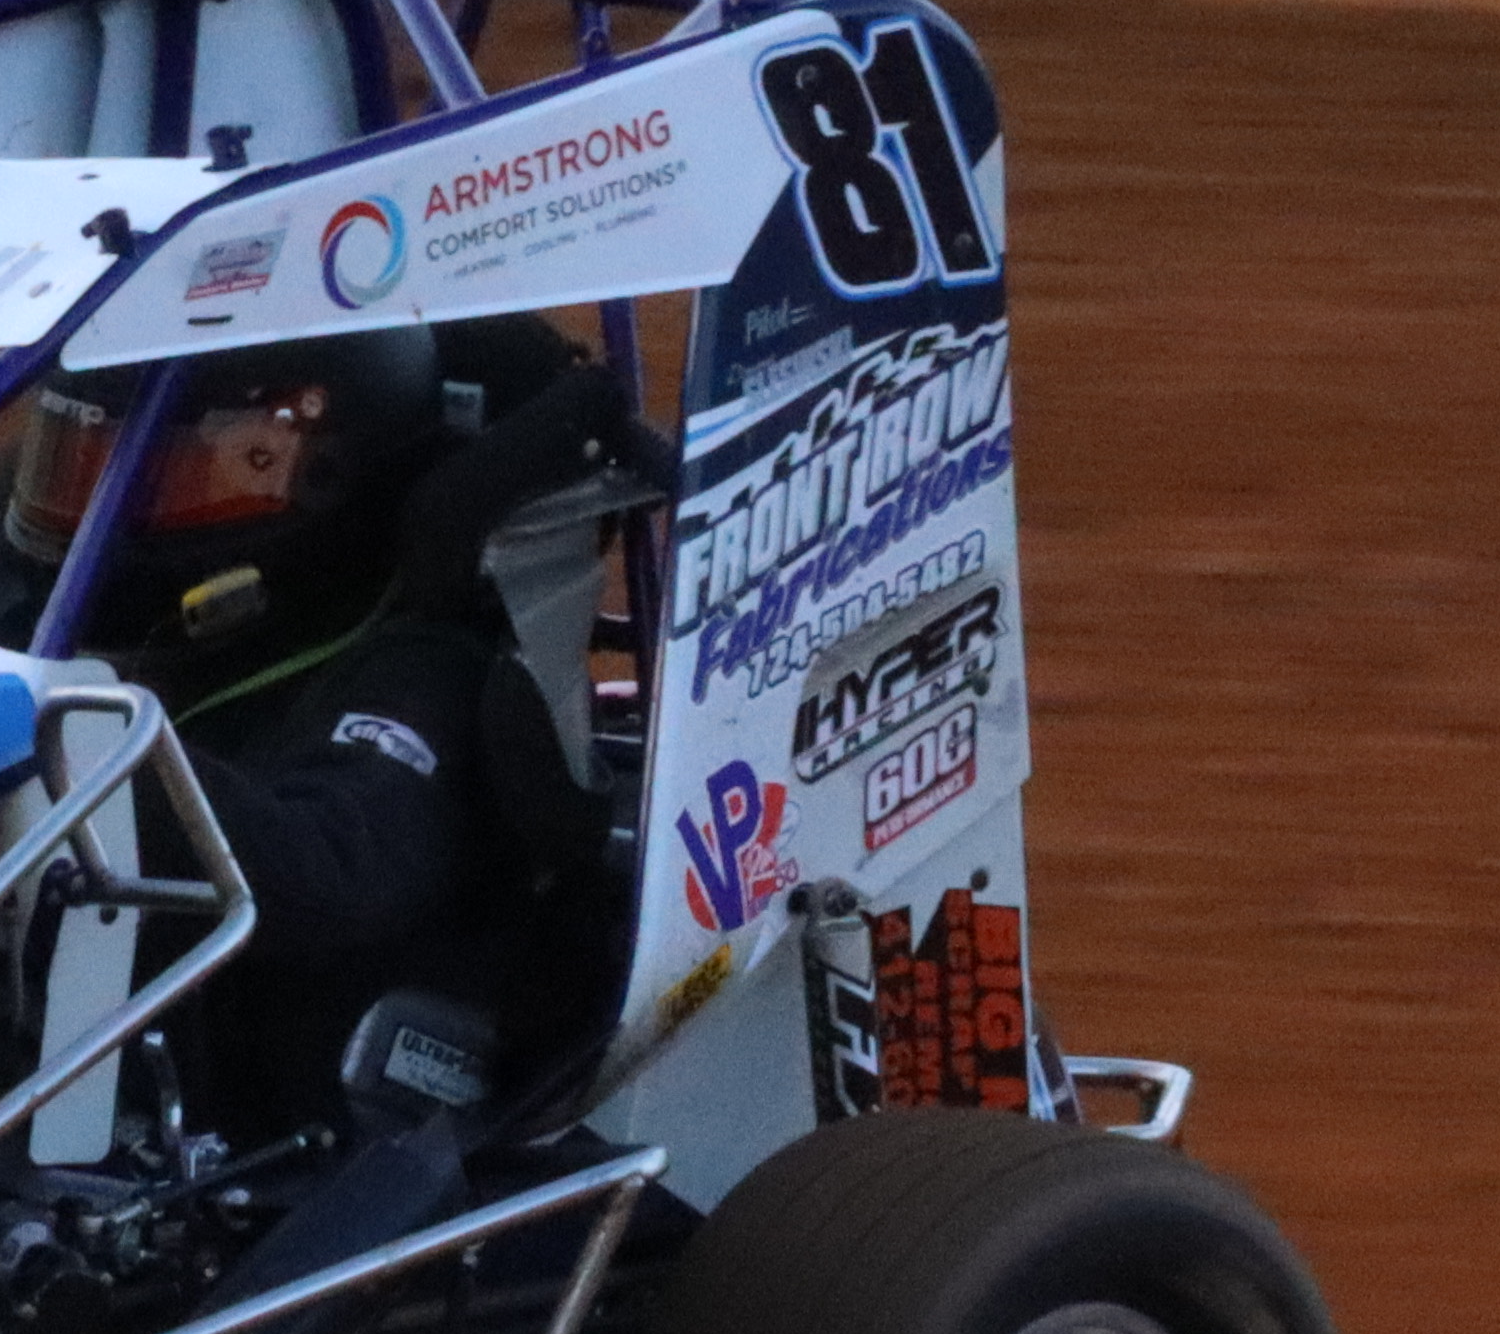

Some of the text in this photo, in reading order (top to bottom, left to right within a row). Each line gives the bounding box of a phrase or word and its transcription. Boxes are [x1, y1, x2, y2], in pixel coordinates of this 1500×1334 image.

[421, 109, 673, 223] ARMSTRONG
[424, 201, 538, 264] COMFORT
[752, 15, 1002, 301] 81
[670, 327, 1010, 640] FRONT ROW
[691, 424, 1013, 705] Fabrications
[792, 585, 1003, 759] HYPER
[675, 759, 765, 933] VP
